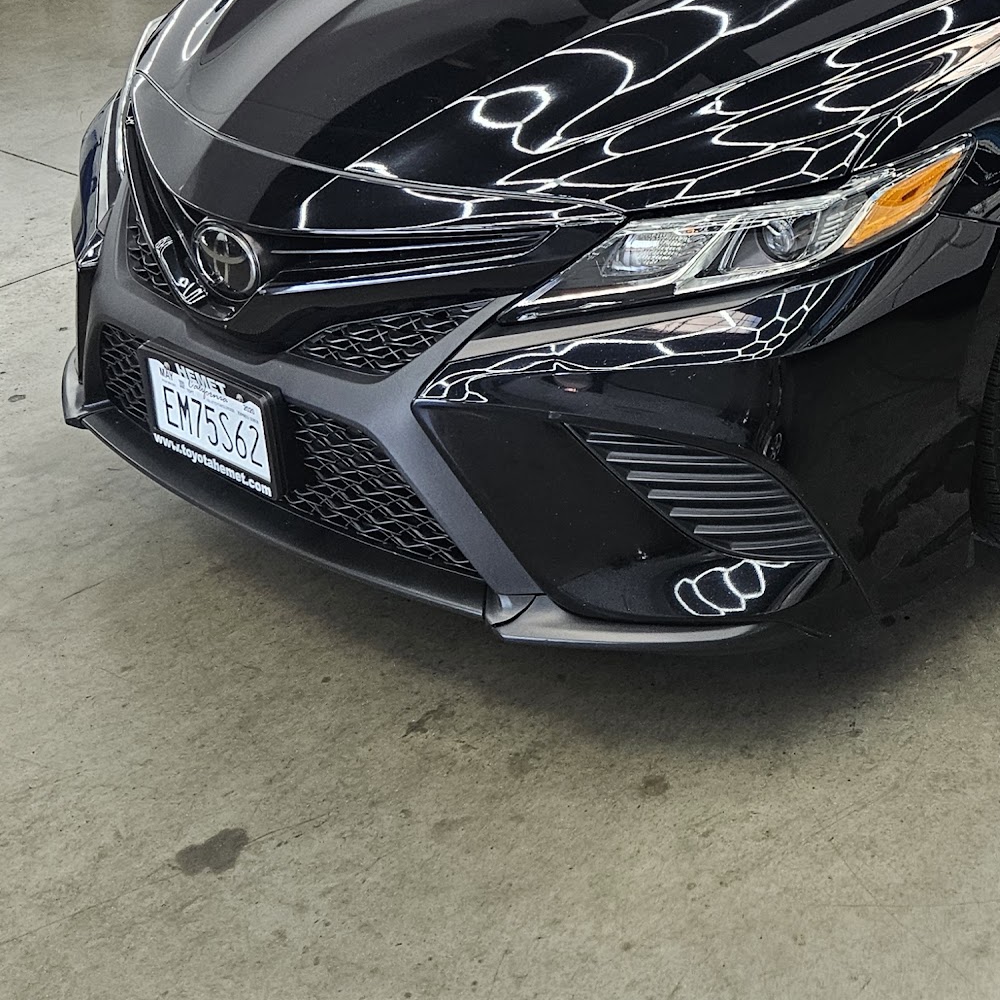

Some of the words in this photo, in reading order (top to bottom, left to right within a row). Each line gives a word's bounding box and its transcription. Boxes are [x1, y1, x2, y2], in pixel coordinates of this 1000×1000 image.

[159, 366, 174, 381] MAY
[174, 362, 227, 396] HEMET
[163, 385, 263, 468] EM75S62
[152, 432, 273, 498] www.toyotahemet.com
